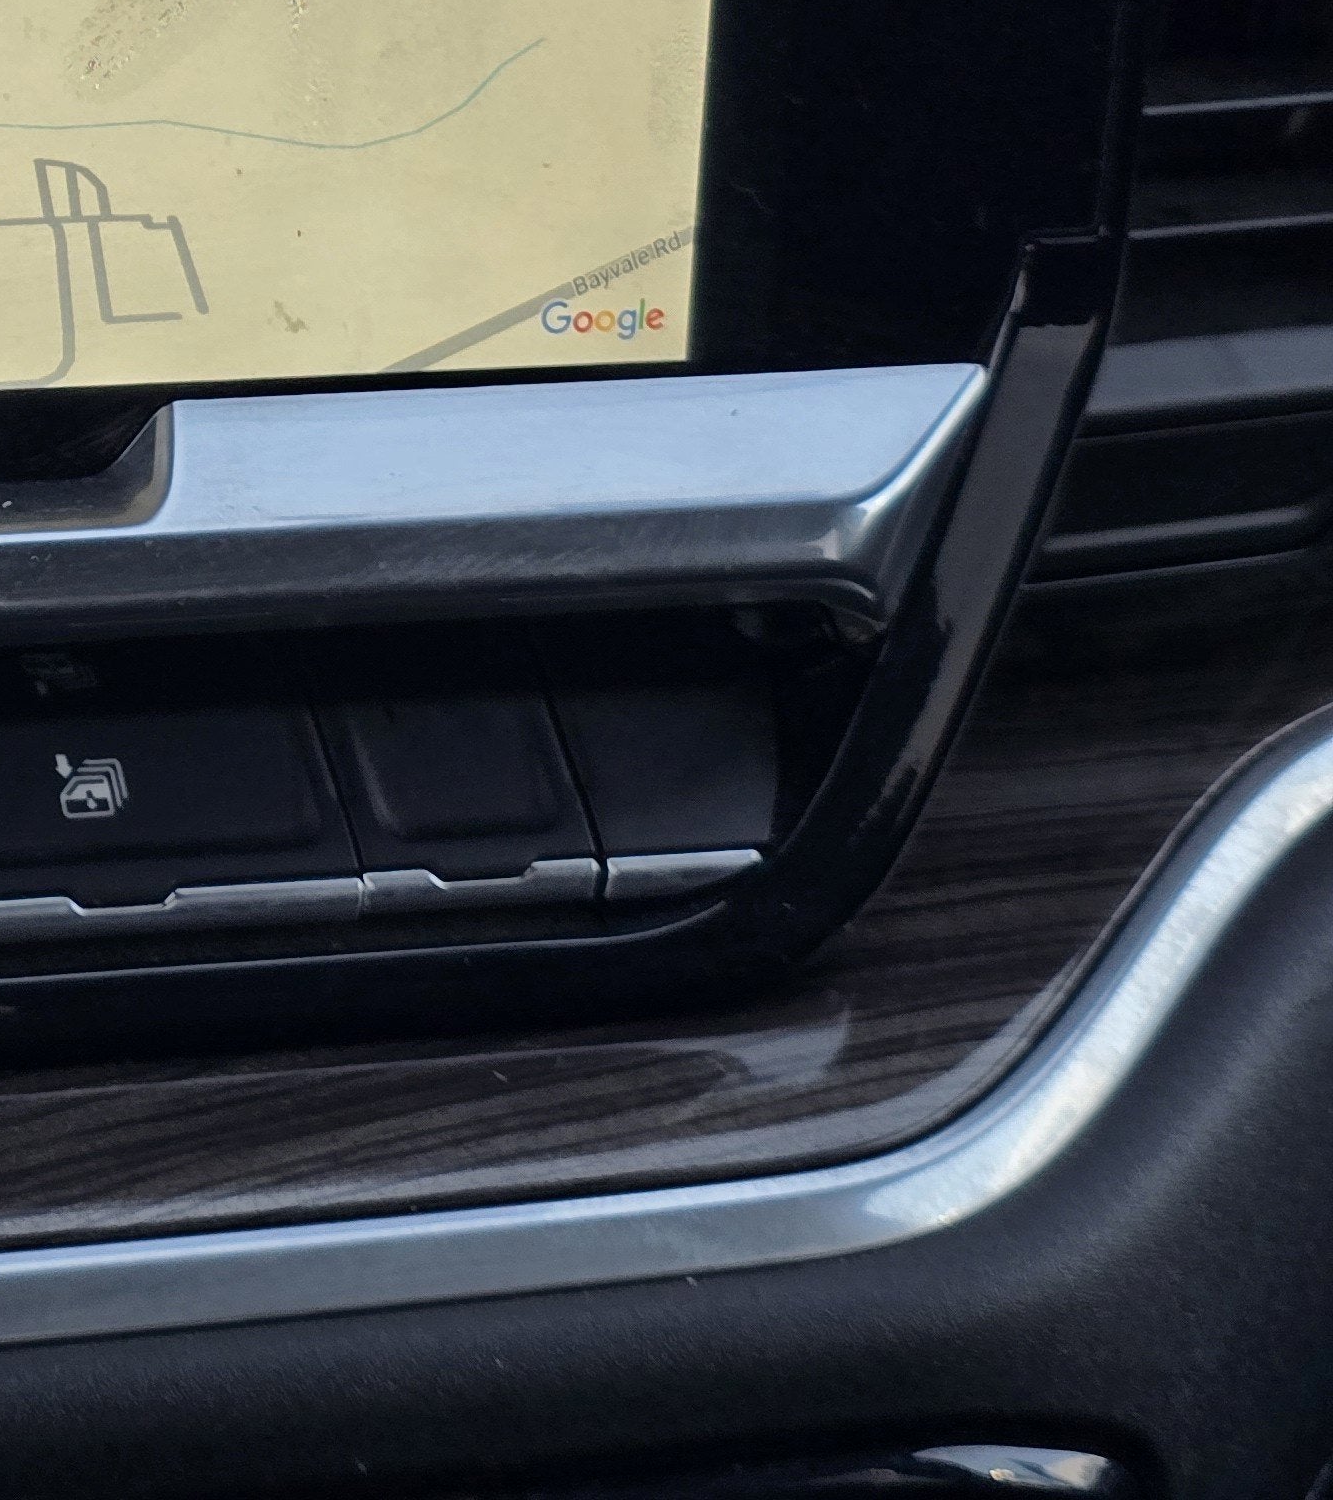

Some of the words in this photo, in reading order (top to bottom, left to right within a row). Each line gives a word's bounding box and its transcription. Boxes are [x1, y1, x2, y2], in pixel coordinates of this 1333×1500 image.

[572, 250, 652, 296] Bayvale
[653, 230, 682, 259] Rd
[541, 297, 665, 340] Google
